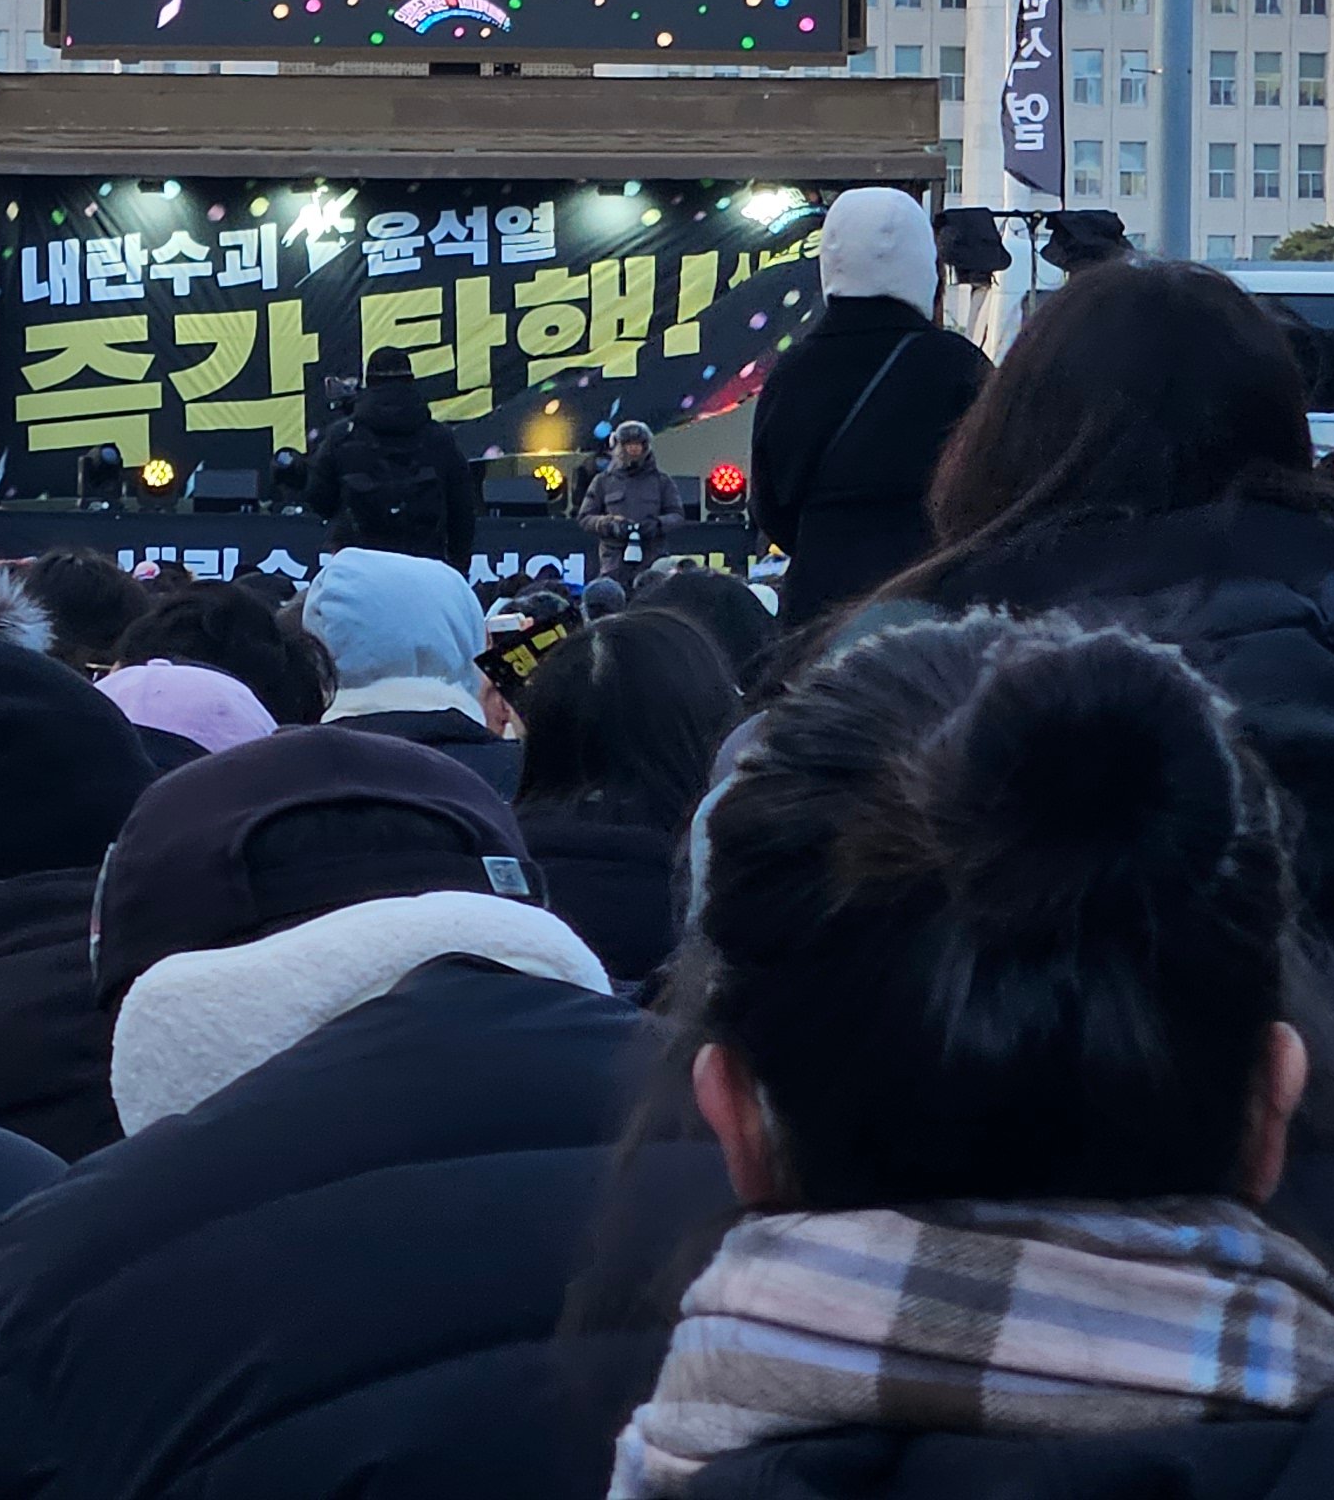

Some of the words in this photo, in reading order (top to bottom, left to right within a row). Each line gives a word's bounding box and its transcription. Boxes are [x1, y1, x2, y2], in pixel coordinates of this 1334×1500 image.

[20, 223, 279, 306] 내란수괴
[361, 201, 558, 278] 윤석열
[15, 299, 320, 469] 즉각
[360, 250, 719, 423] 탄핵!
